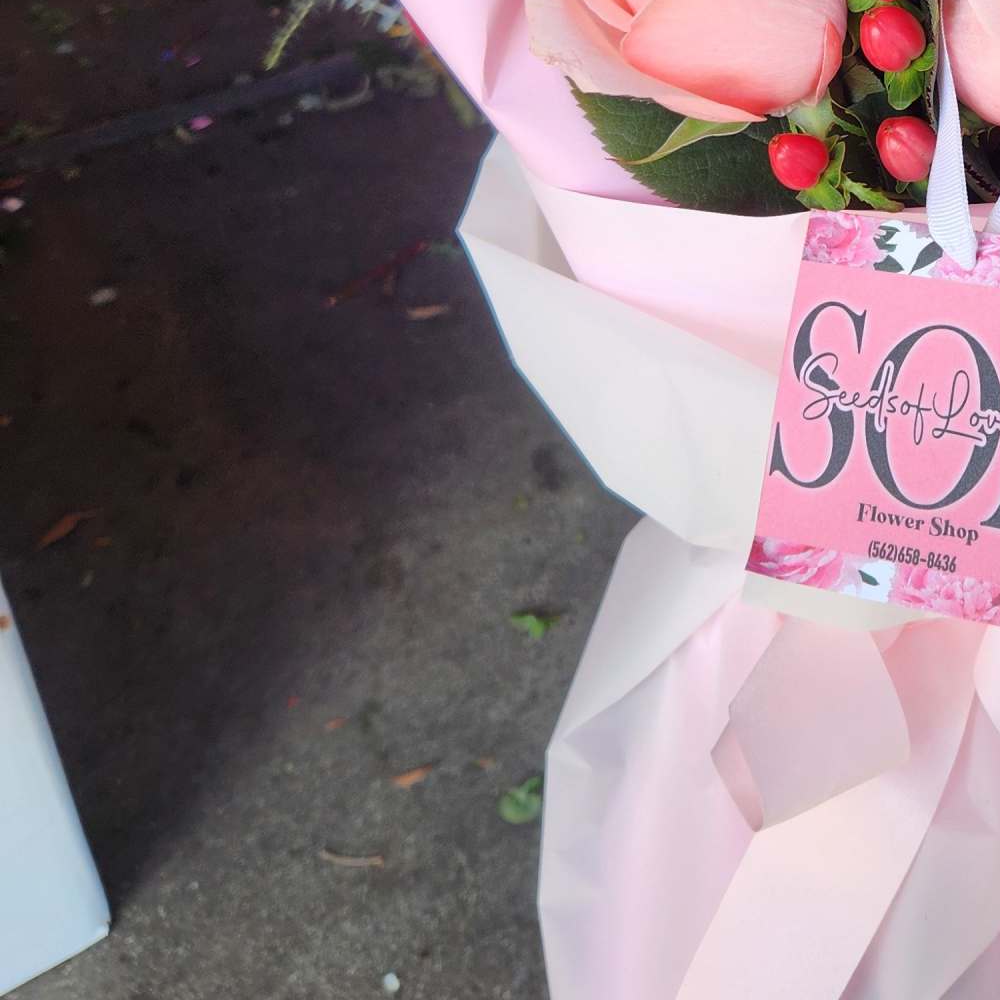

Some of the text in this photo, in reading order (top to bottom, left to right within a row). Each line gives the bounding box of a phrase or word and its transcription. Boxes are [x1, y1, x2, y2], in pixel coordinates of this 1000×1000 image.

[857, 503, 979, 545] Flower Shop
[868, 541, 957, 573] (562)658-8436
